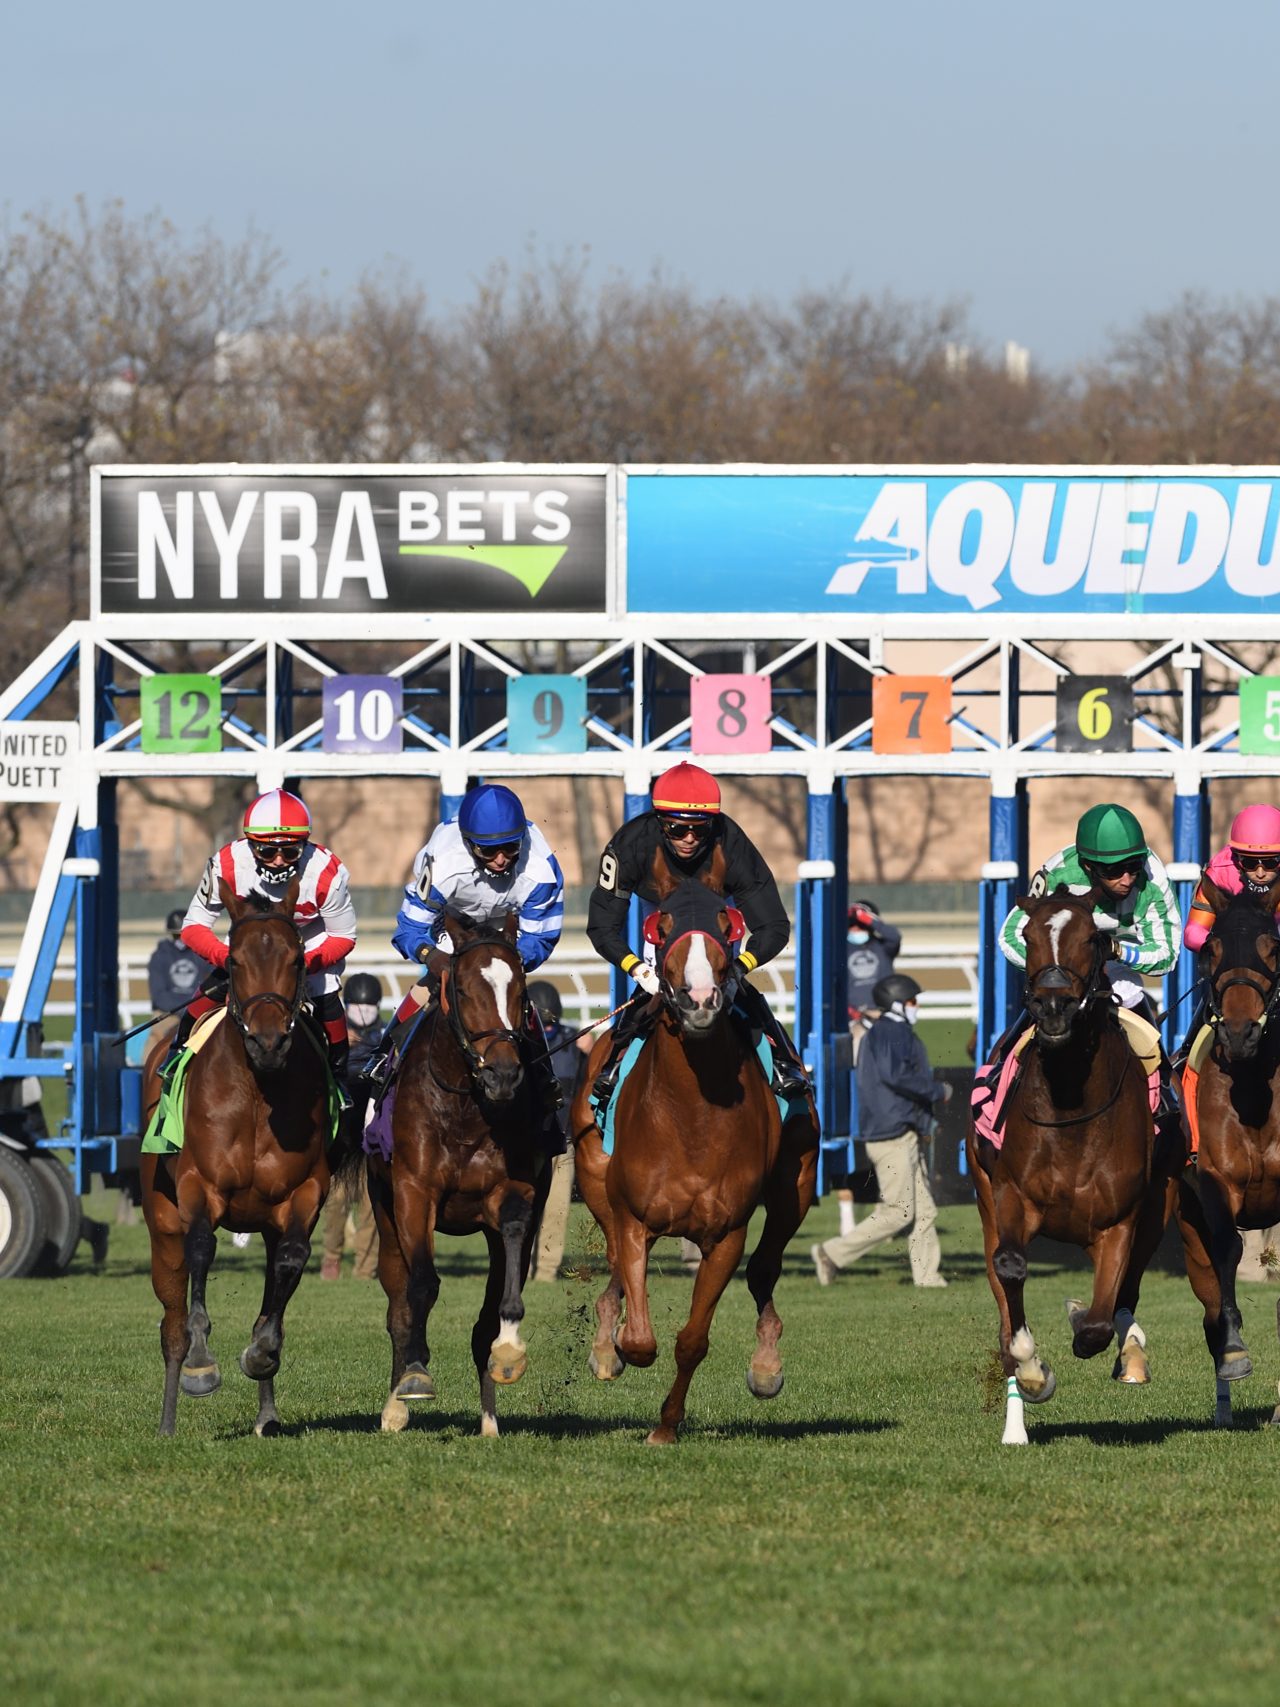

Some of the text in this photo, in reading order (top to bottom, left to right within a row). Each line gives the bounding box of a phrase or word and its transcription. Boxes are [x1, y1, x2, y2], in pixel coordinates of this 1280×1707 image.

[137, 490, 571, 599] NYRA BETS
[153, 691, 210, 740] 12
[334, 690, 393, 741] 10
[534, 691, 564, 739] 9
[717, 690, 747, 738] 8
[899, 691, 929, 739] 7
[1078, 688, 1111, 740] 6
[0, 735, 67, 756] NITED
[600, 854, 616, 890] 9
